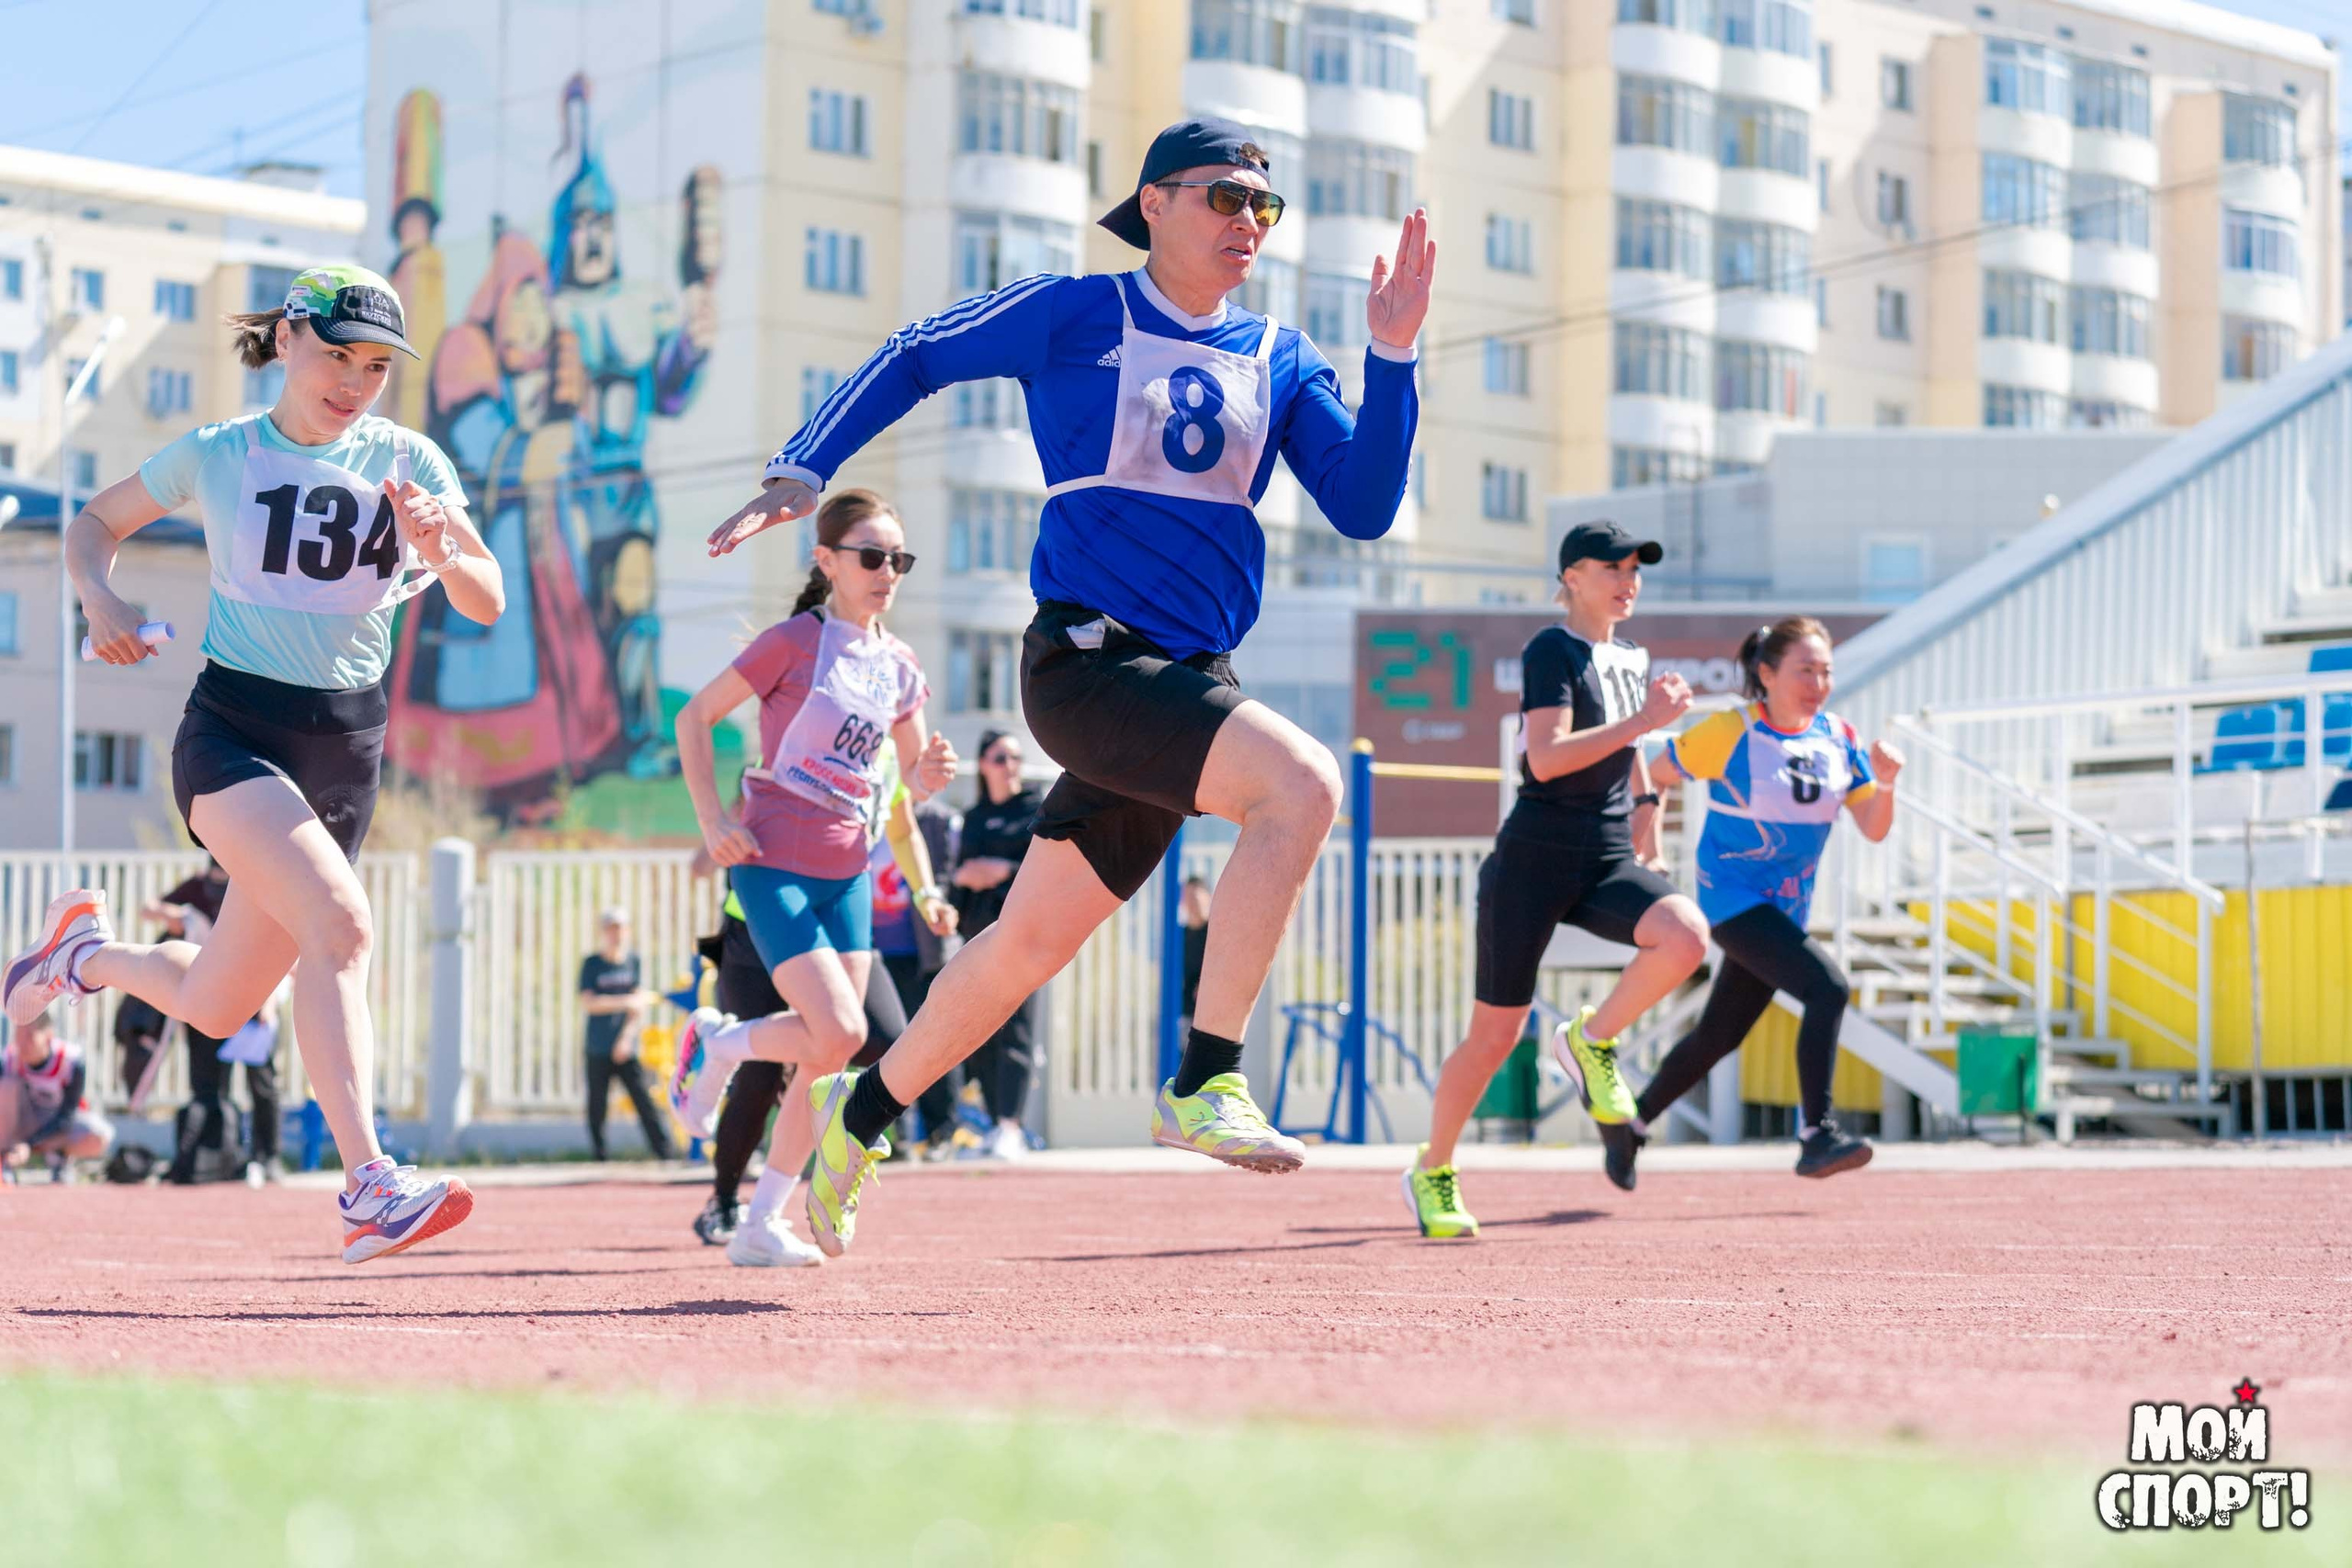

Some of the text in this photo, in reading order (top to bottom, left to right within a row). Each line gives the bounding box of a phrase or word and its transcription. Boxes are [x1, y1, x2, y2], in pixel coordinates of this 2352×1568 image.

[1097, 357, 1121, 367] adid
[1161, 366, 1226, 474] 8
[254, 484, 400, 582] 134
[1372, 631, 1470, 707] 21
